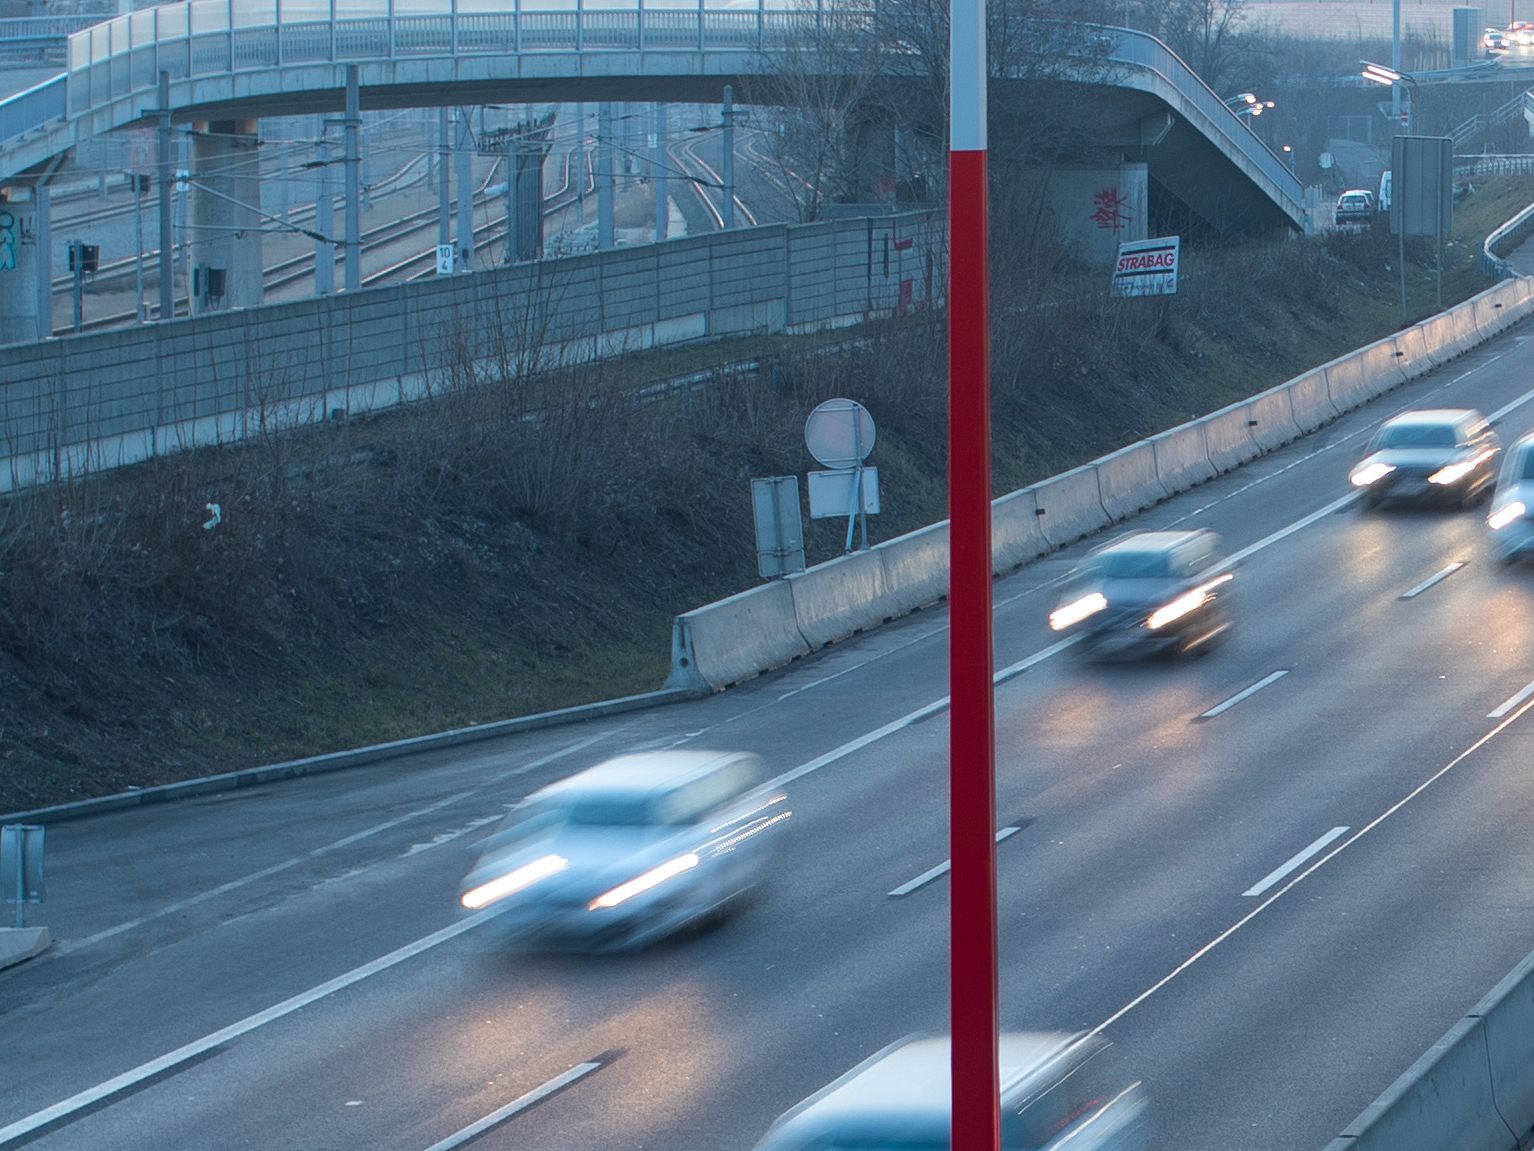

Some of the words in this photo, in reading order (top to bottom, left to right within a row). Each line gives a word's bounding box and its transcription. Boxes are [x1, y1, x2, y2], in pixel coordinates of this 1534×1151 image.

[440, 247, 450, 258] 10
[442, 260, 448, 270] 4
[1117, 253, 1175, 271] STRABAG
